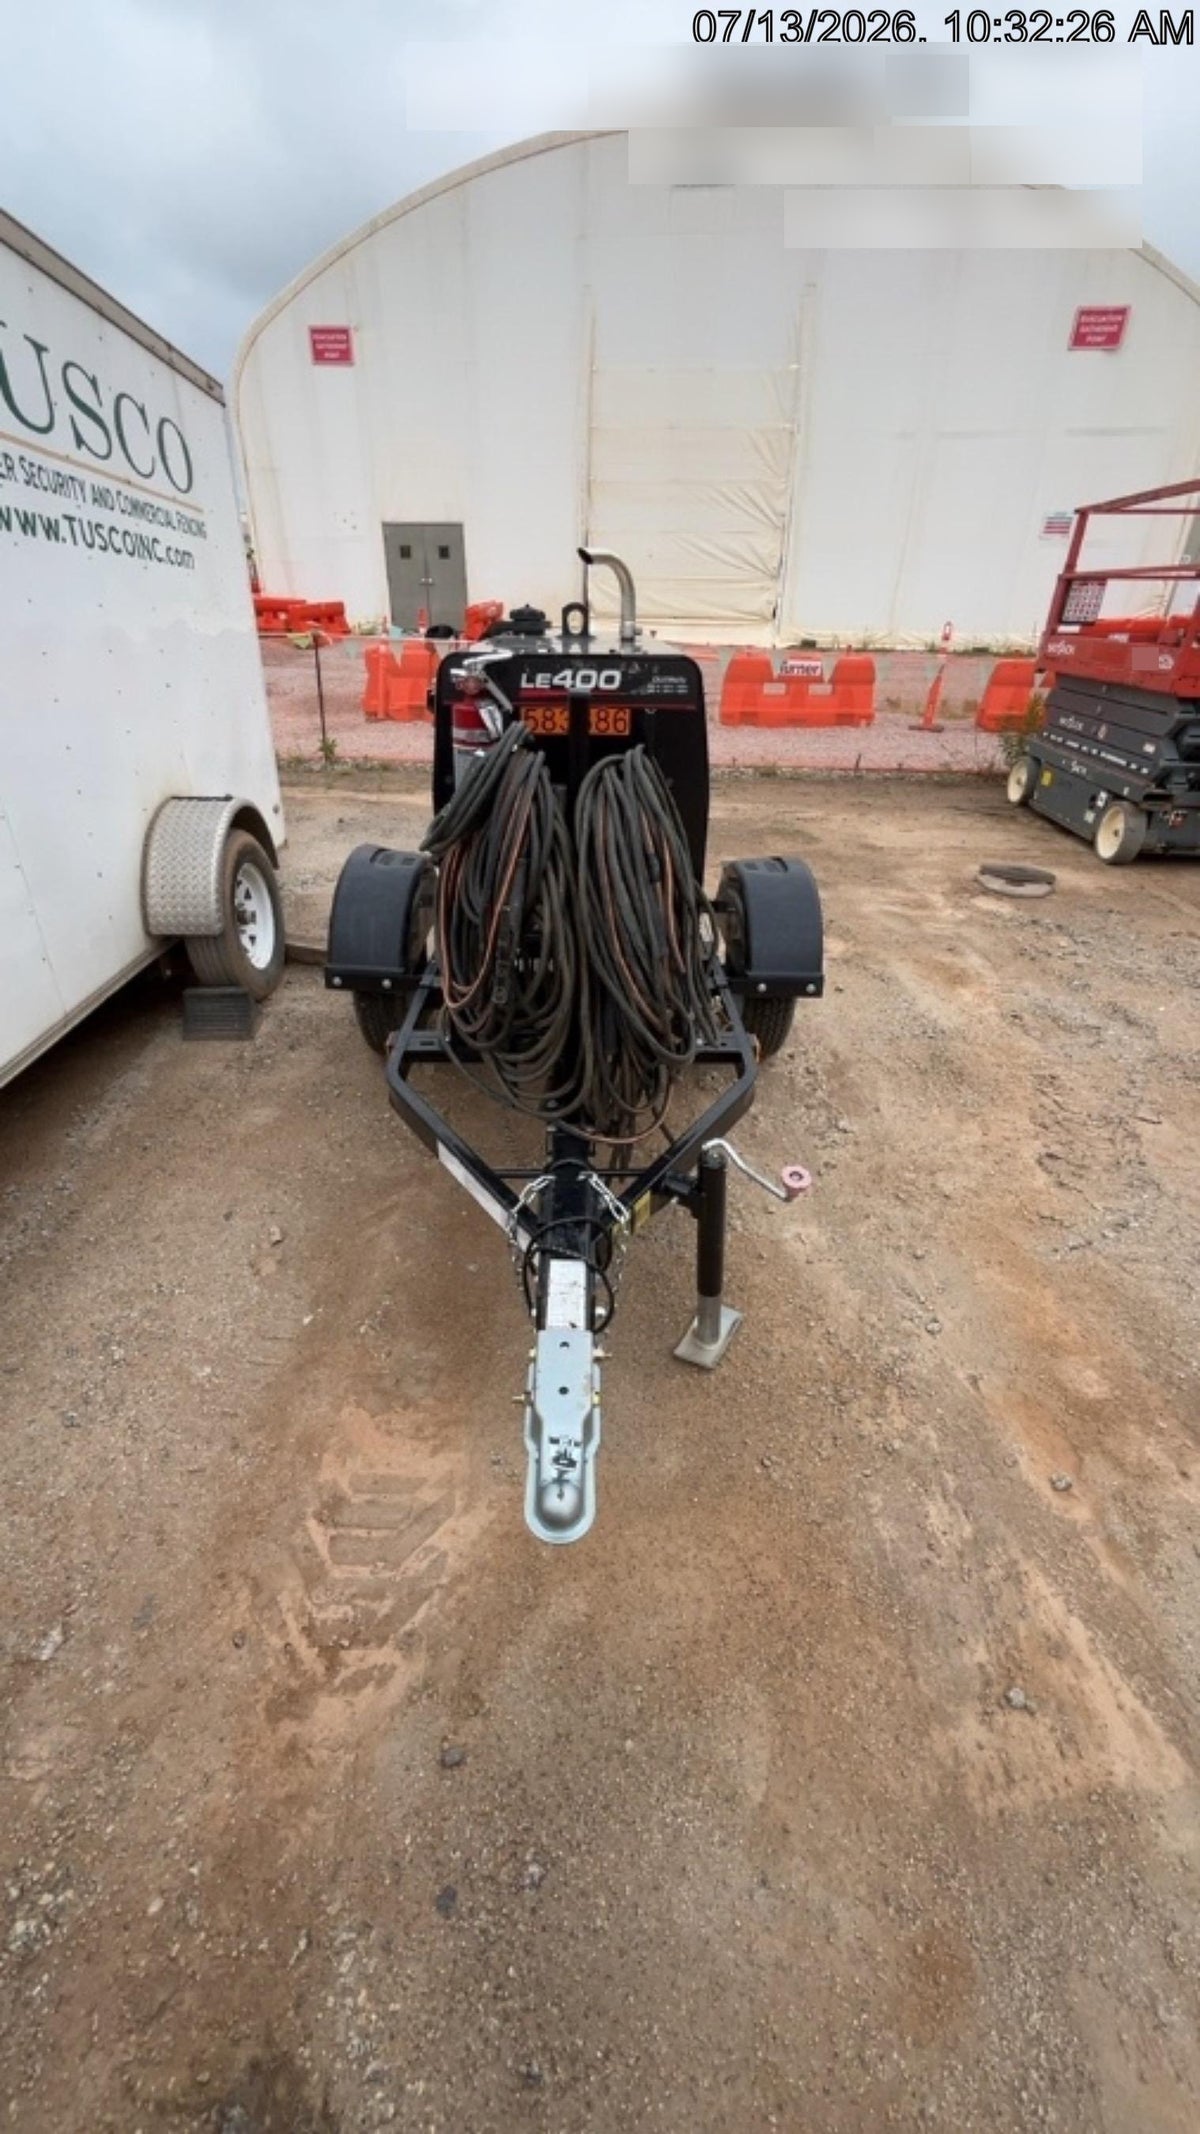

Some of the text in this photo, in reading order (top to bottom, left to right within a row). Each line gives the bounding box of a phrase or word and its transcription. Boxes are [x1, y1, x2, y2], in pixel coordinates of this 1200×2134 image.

[19, 454, 86, 503] SECURITY
[91, 482, 114, 511] AND
[116, 490, 176, 531] COMMERCIAL
[175, 510, 207, 539] FENCING
[521, 669, 622, 689] LE400
